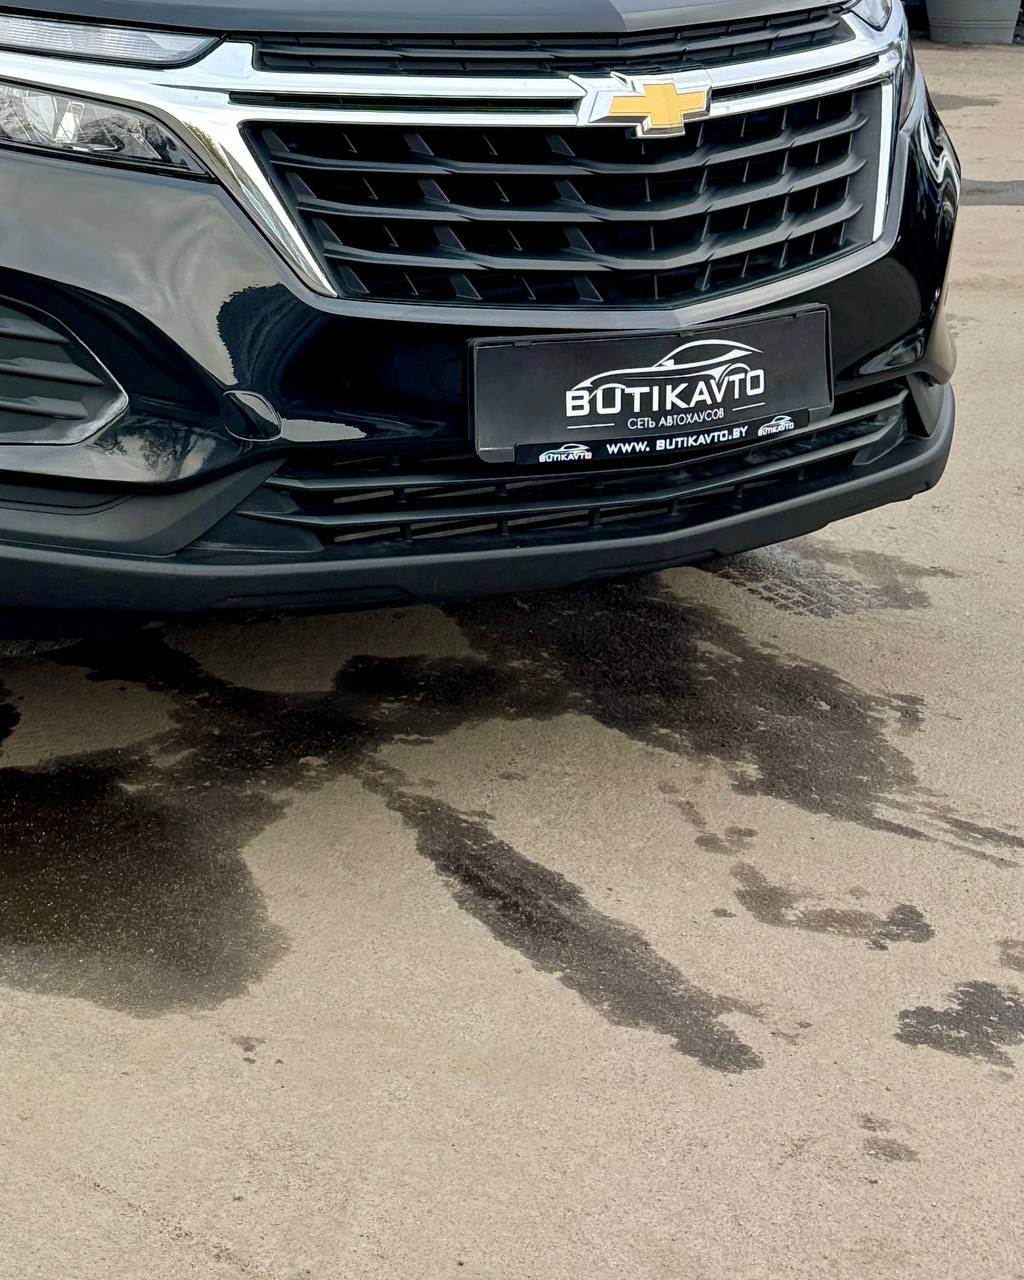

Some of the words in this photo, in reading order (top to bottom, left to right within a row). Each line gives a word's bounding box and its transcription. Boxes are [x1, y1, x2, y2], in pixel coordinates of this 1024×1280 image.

[565, 369, 765, 417] BUTIKAVTO
[627, 417, 656, 431] СЕТЬ
[658, 407, 725, 429] АВТОХАУСОВ
[655, 425, 749, 452] BUTIKAVTO.BY
